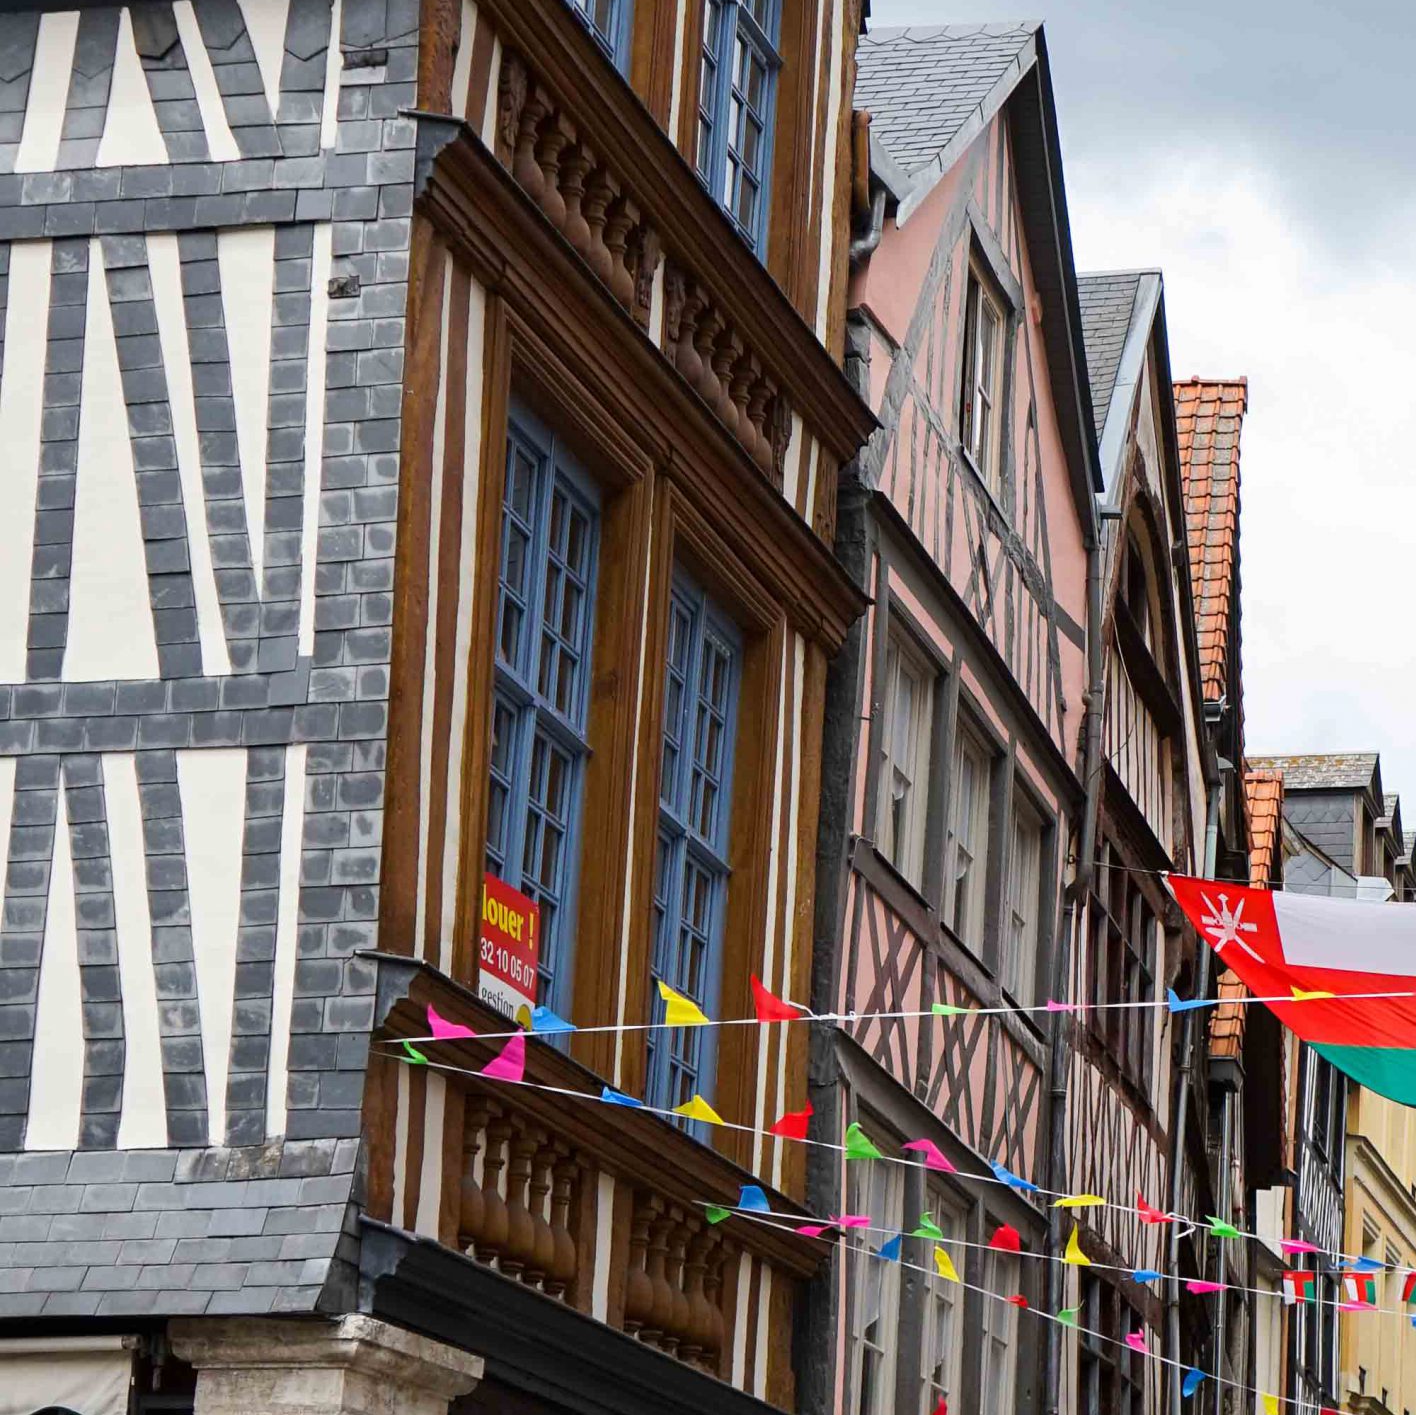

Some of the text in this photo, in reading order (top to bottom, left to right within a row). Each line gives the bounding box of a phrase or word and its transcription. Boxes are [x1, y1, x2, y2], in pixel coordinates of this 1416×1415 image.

[482, 884, 524, 942] louer
[481, 937, 534, 990] 32 10 05 07
[482, 986, 514, 1021] gestion
